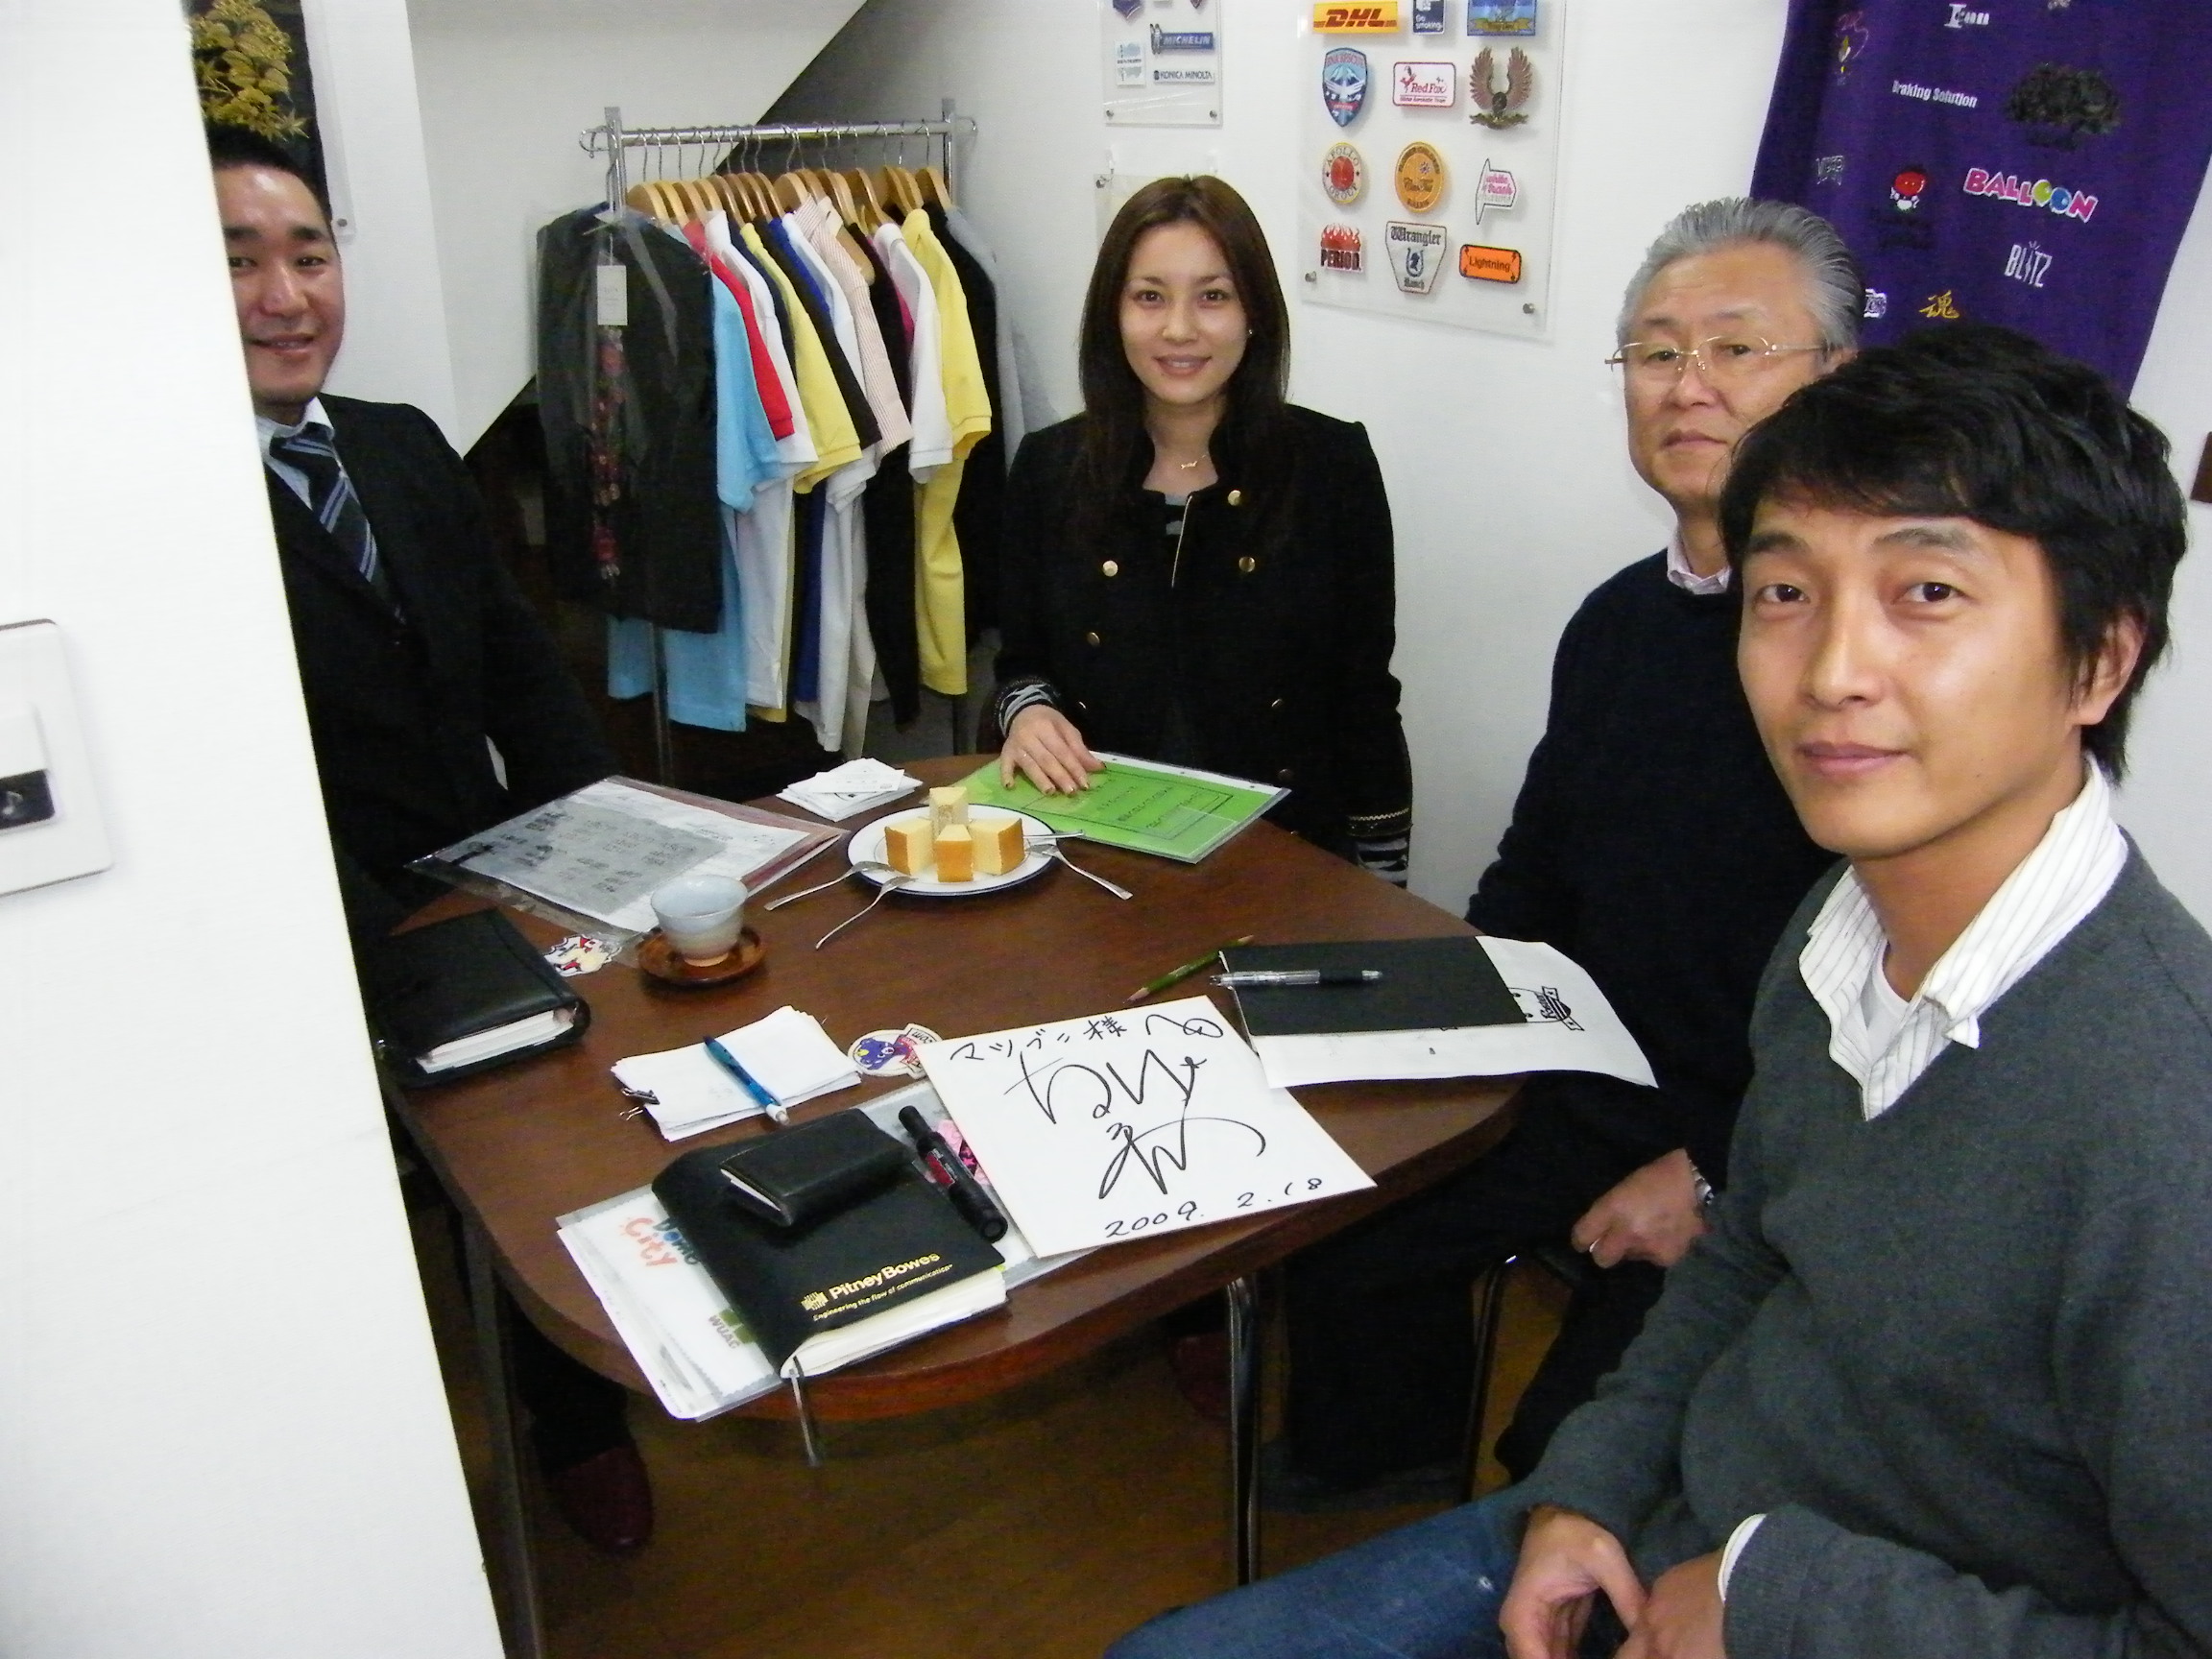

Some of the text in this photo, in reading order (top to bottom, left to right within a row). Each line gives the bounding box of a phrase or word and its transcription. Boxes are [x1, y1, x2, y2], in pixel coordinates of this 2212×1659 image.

[1325, 8, 1384, 28] DHL
[1163, 36, 1211, 46] MICHELIN
[1160, 70, 1213, 80] KONICA MINOLTA
[1410, 82, 1448, 94] Red Fox
[1891, 79, 1978, 108] Braking Solution
[1327, 146, 1359, 167] APOLLO
[1328, 182, 1358, 199] GROUP
[1963, 167, 2099, 224] BALLOON
[1390, 226, 1442, 247] Wrangler
[1468, 254, 1512, 273] Lightning
[2004, 242, 2053, 288] BLITZ
[1918, 289, 1960, 319] 魂
[622, 1216, 679, 1267] City
